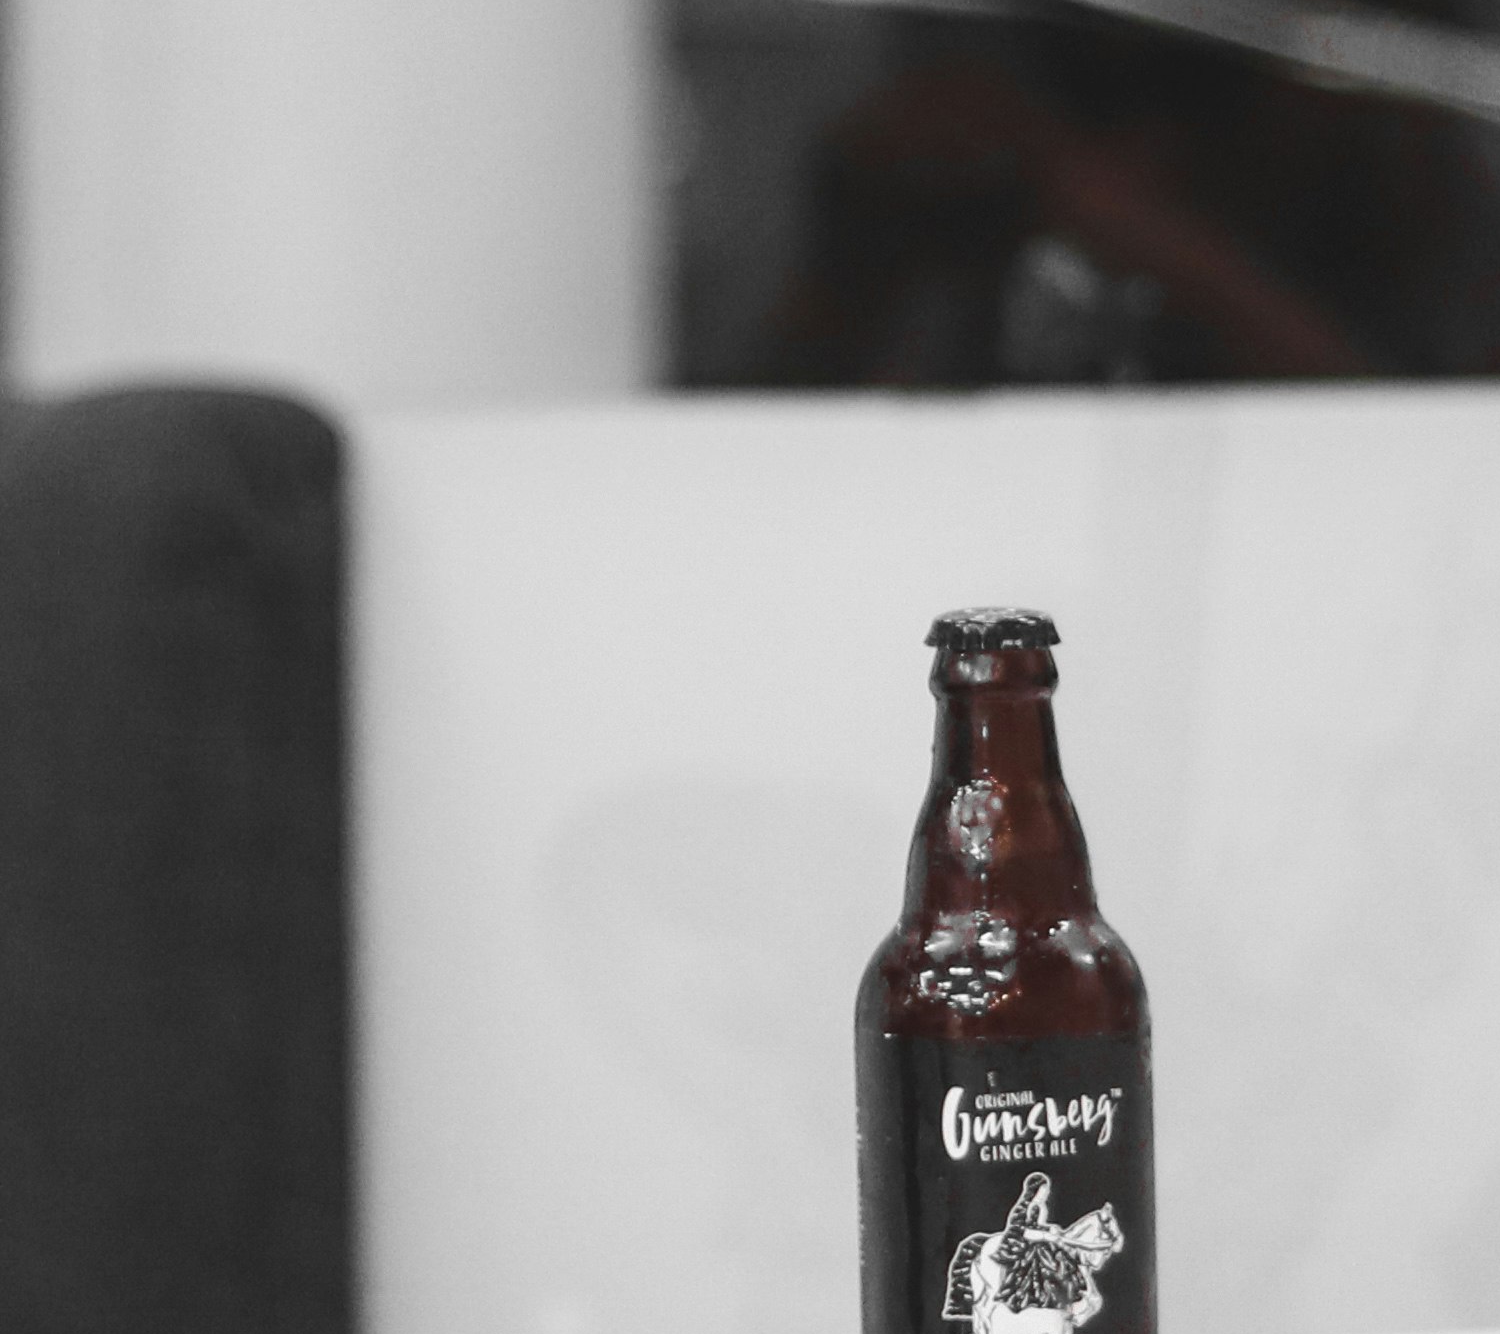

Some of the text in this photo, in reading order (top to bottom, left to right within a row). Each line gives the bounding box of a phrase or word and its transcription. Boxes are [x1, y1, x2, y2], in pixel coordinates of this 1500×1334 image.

[975, 1090, 1035, 1110] ORIGINAL
[942, 1086, 1118, 1160] Gunsberg
[979, 1138, 1078, 1162] GINGER ALE
